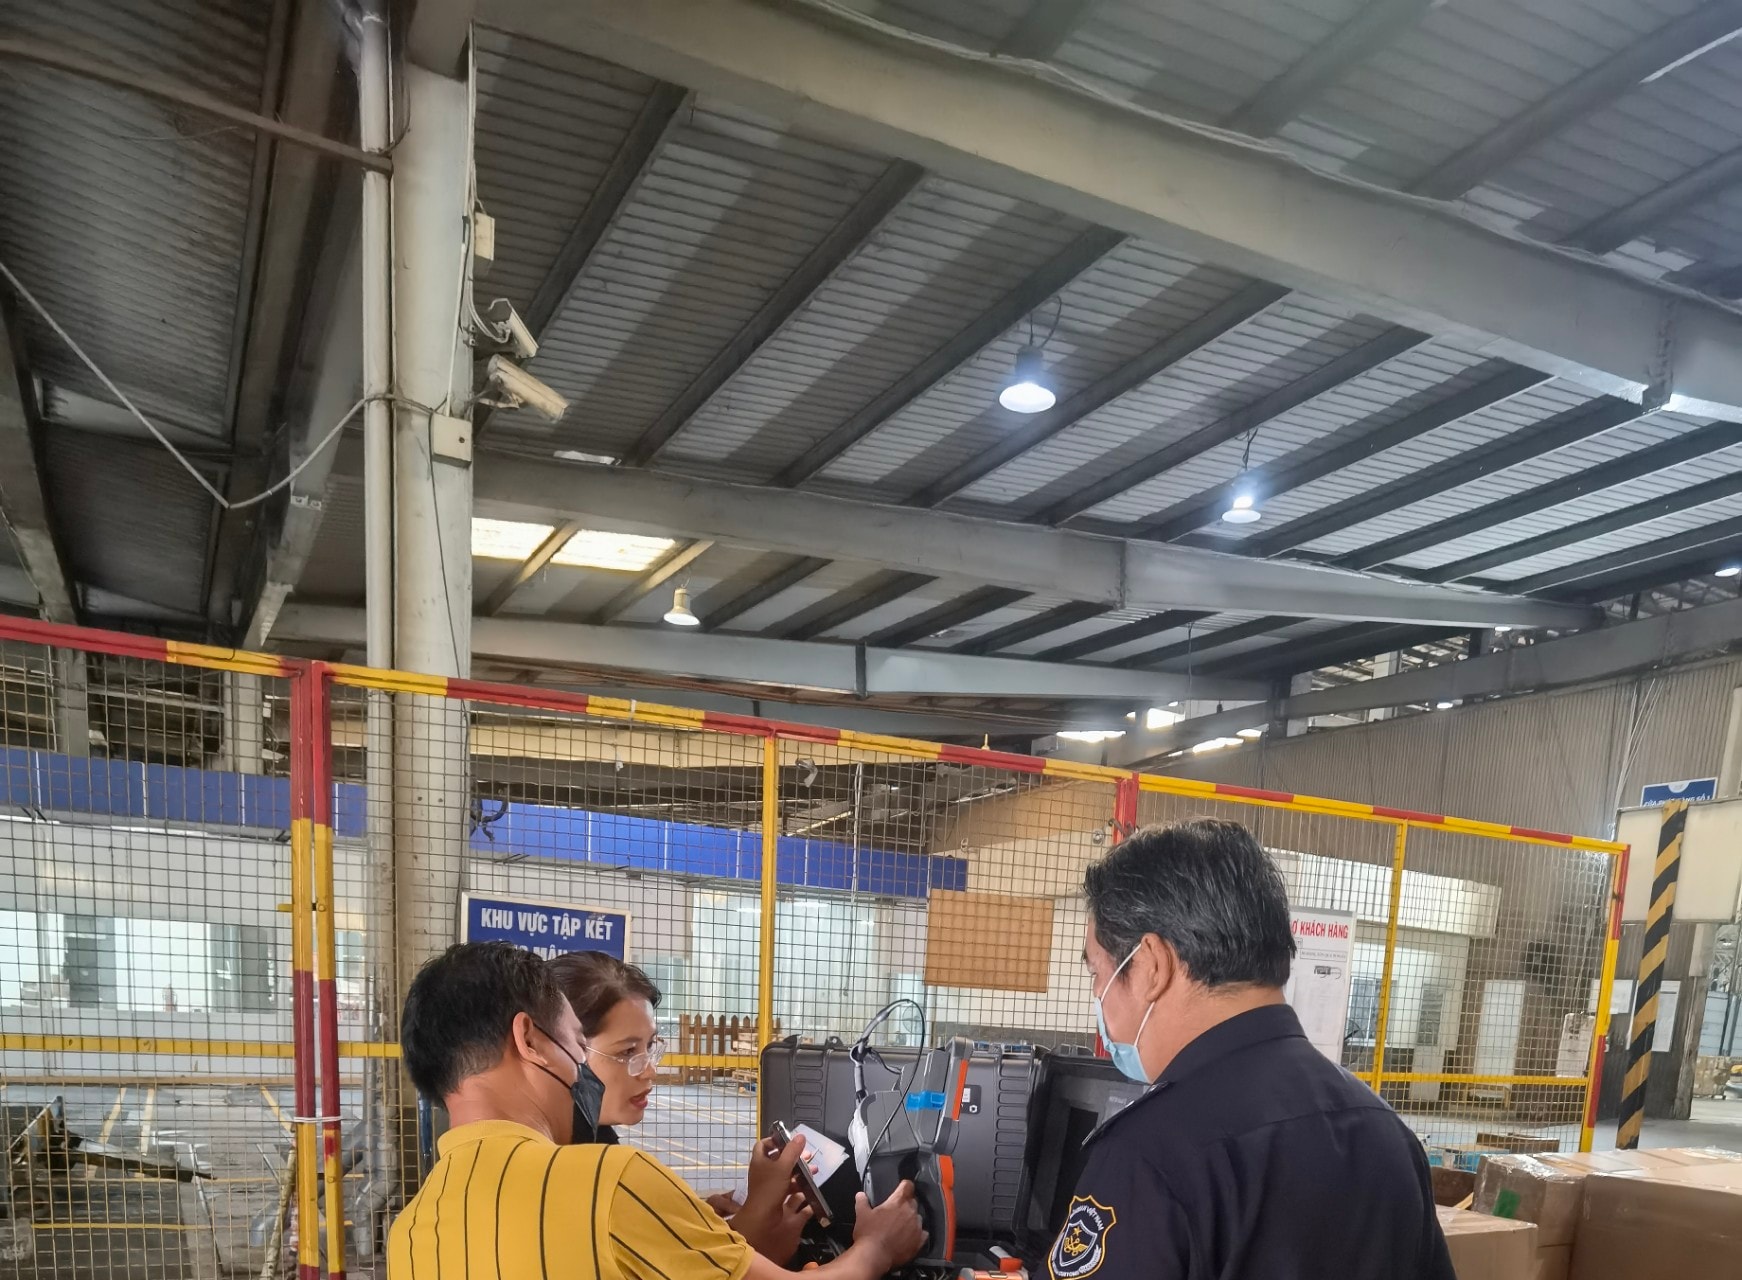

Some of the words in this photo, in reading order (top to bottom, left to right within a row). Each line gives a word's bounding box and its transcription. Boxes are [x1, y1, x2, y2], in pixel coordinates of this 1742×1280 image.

[481, 907, 513, 930] KHU
[517, 911, 549, 937] VỰC
[552, 912, 582, 940] TẬP
[585, 914, 613, 941] KẾT
[1300, 919, 1327, 937] KHÁCH
[1328, 921, 1349, 939] HÀNG
